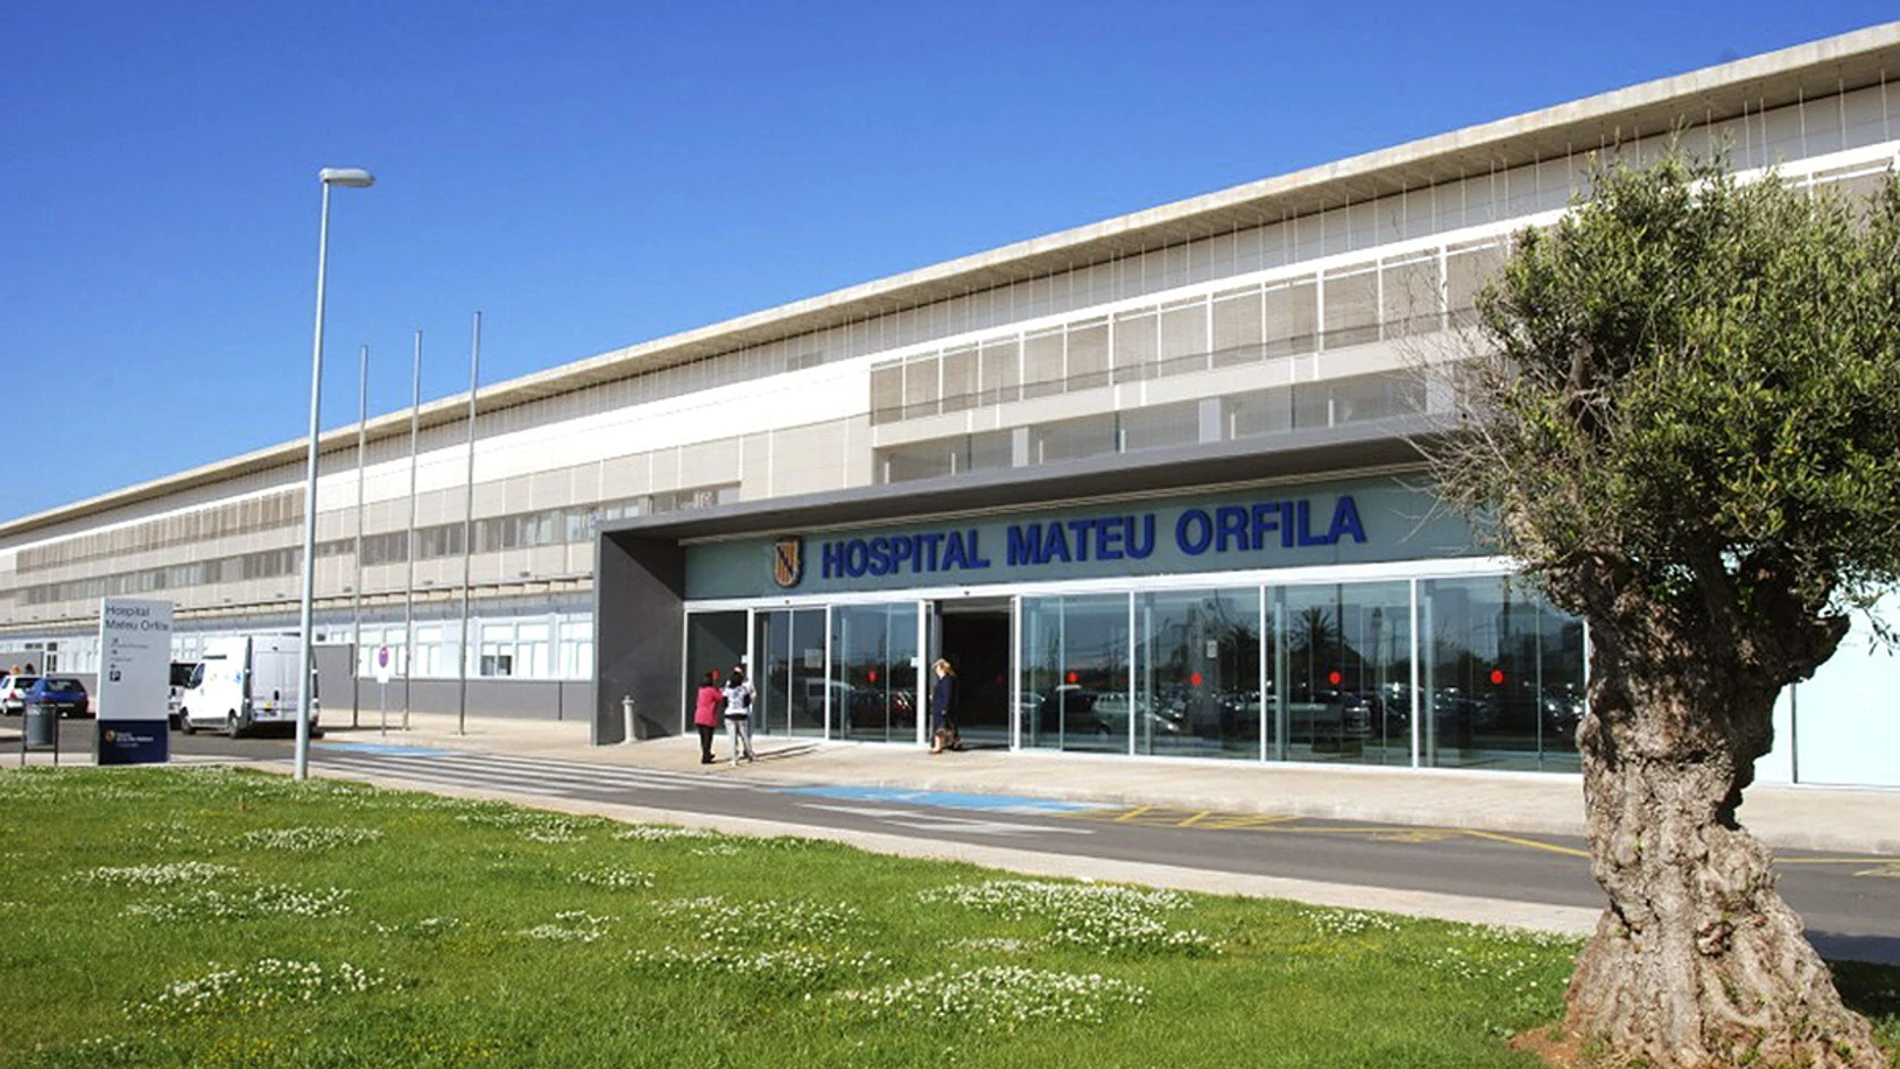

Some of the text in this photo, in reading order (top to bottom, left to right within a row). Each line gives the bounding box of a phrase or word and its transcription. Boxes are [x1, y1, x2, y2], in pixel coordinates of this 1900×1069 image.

[821, 495, 1367, 578] HOSPITAL MATEU ORFILA
[105, 605, 150, 617] Hospital
[105, 619, 138, 631] Mateu
